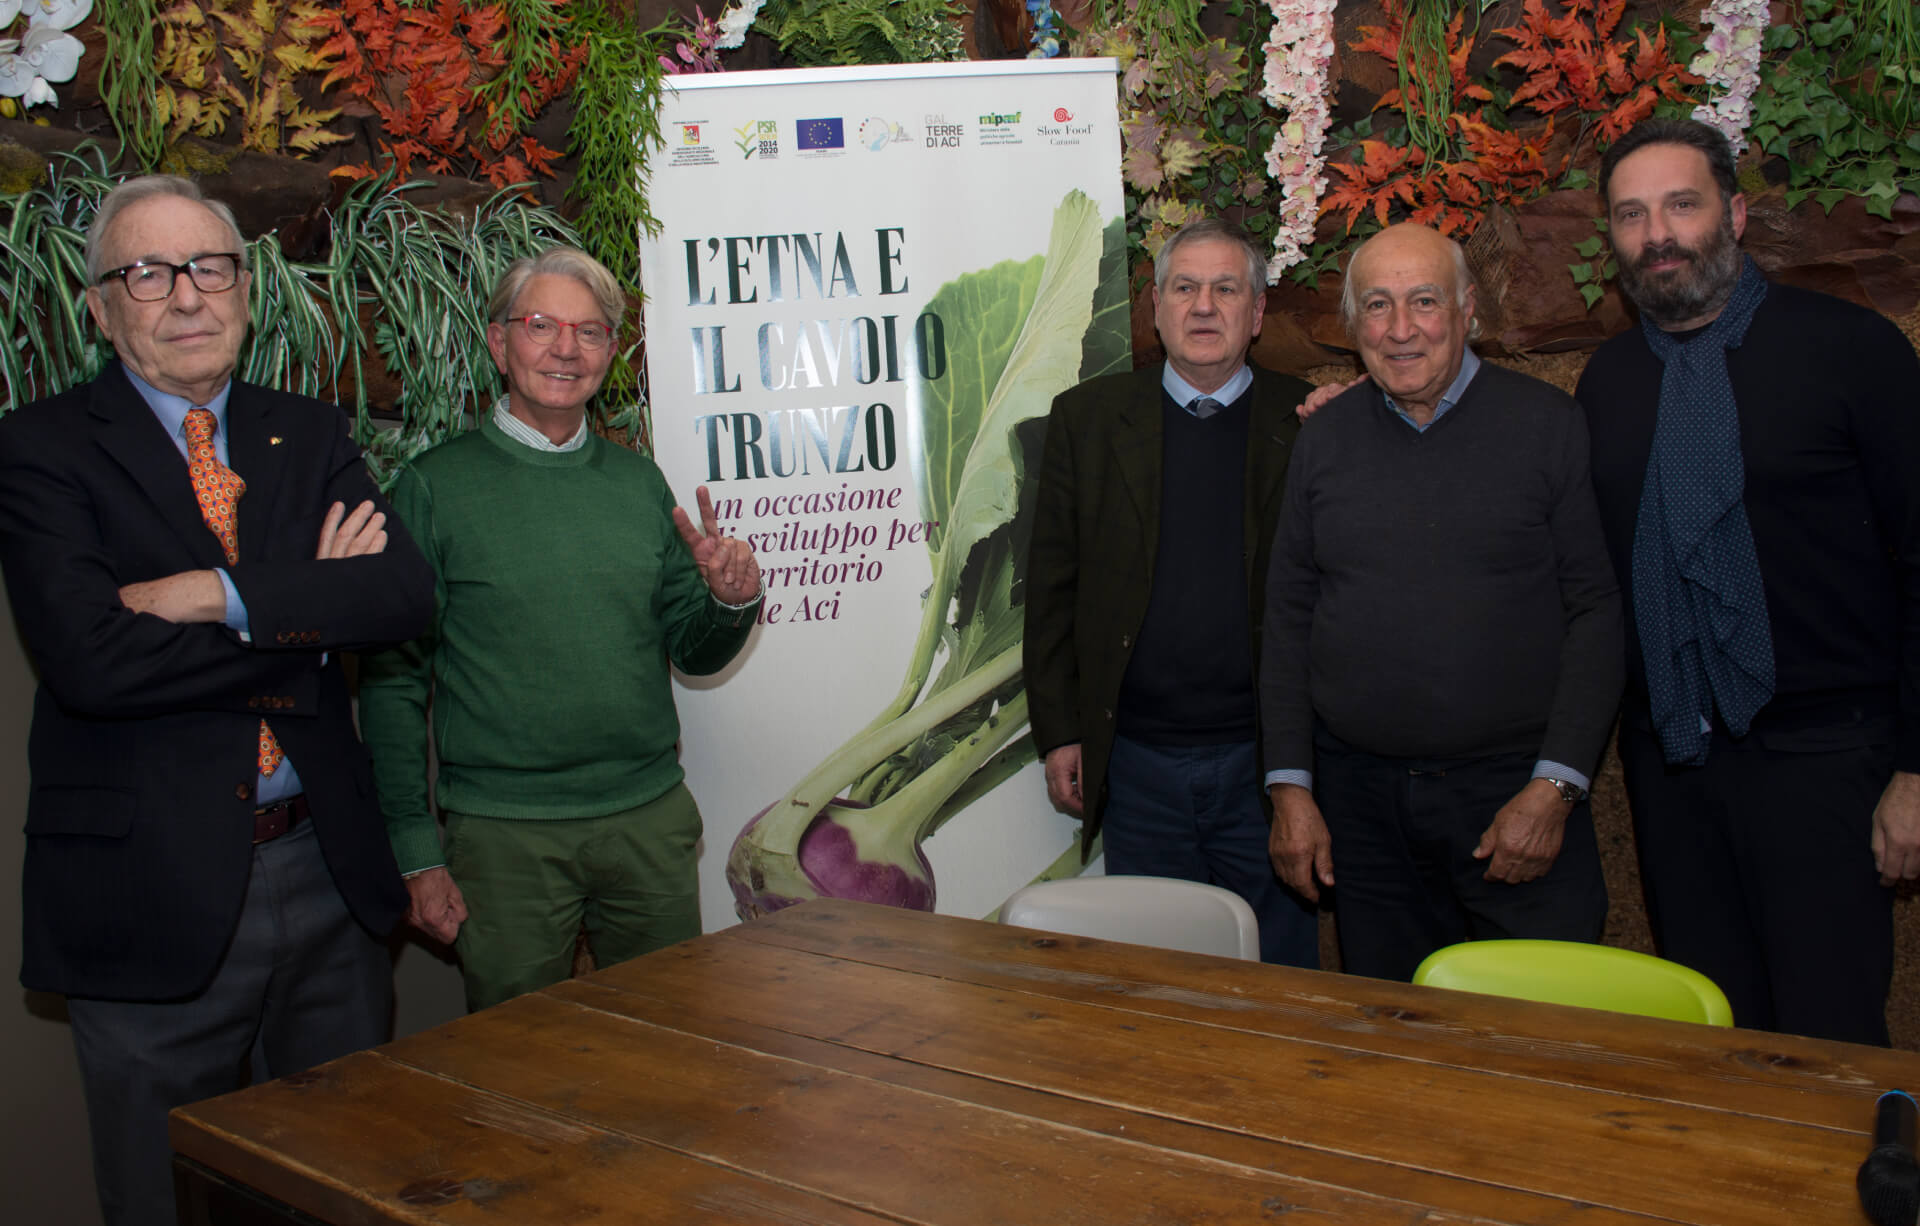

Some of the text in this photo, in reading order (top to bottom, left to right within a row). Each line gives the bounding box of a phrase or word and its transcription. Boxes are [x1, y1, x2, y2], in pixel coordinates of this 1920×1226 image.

[759, 140, 777, 148] 2014
[926, 125, 964, 136] TERRE
[926, 137, 938, 147] DI
[941, 136, 960, 147] ACI
[1037, 125, 1061, 136] Slow
[874, 227, 909, 295] E
[689, 325, 742, 394] IL
[694, 403, 897, 481] TRUNZO
[754, 483, 902, 518] occasione
[747, 519, 940, 555] sviluppo per
[788, 591, 841, 623] Aci
